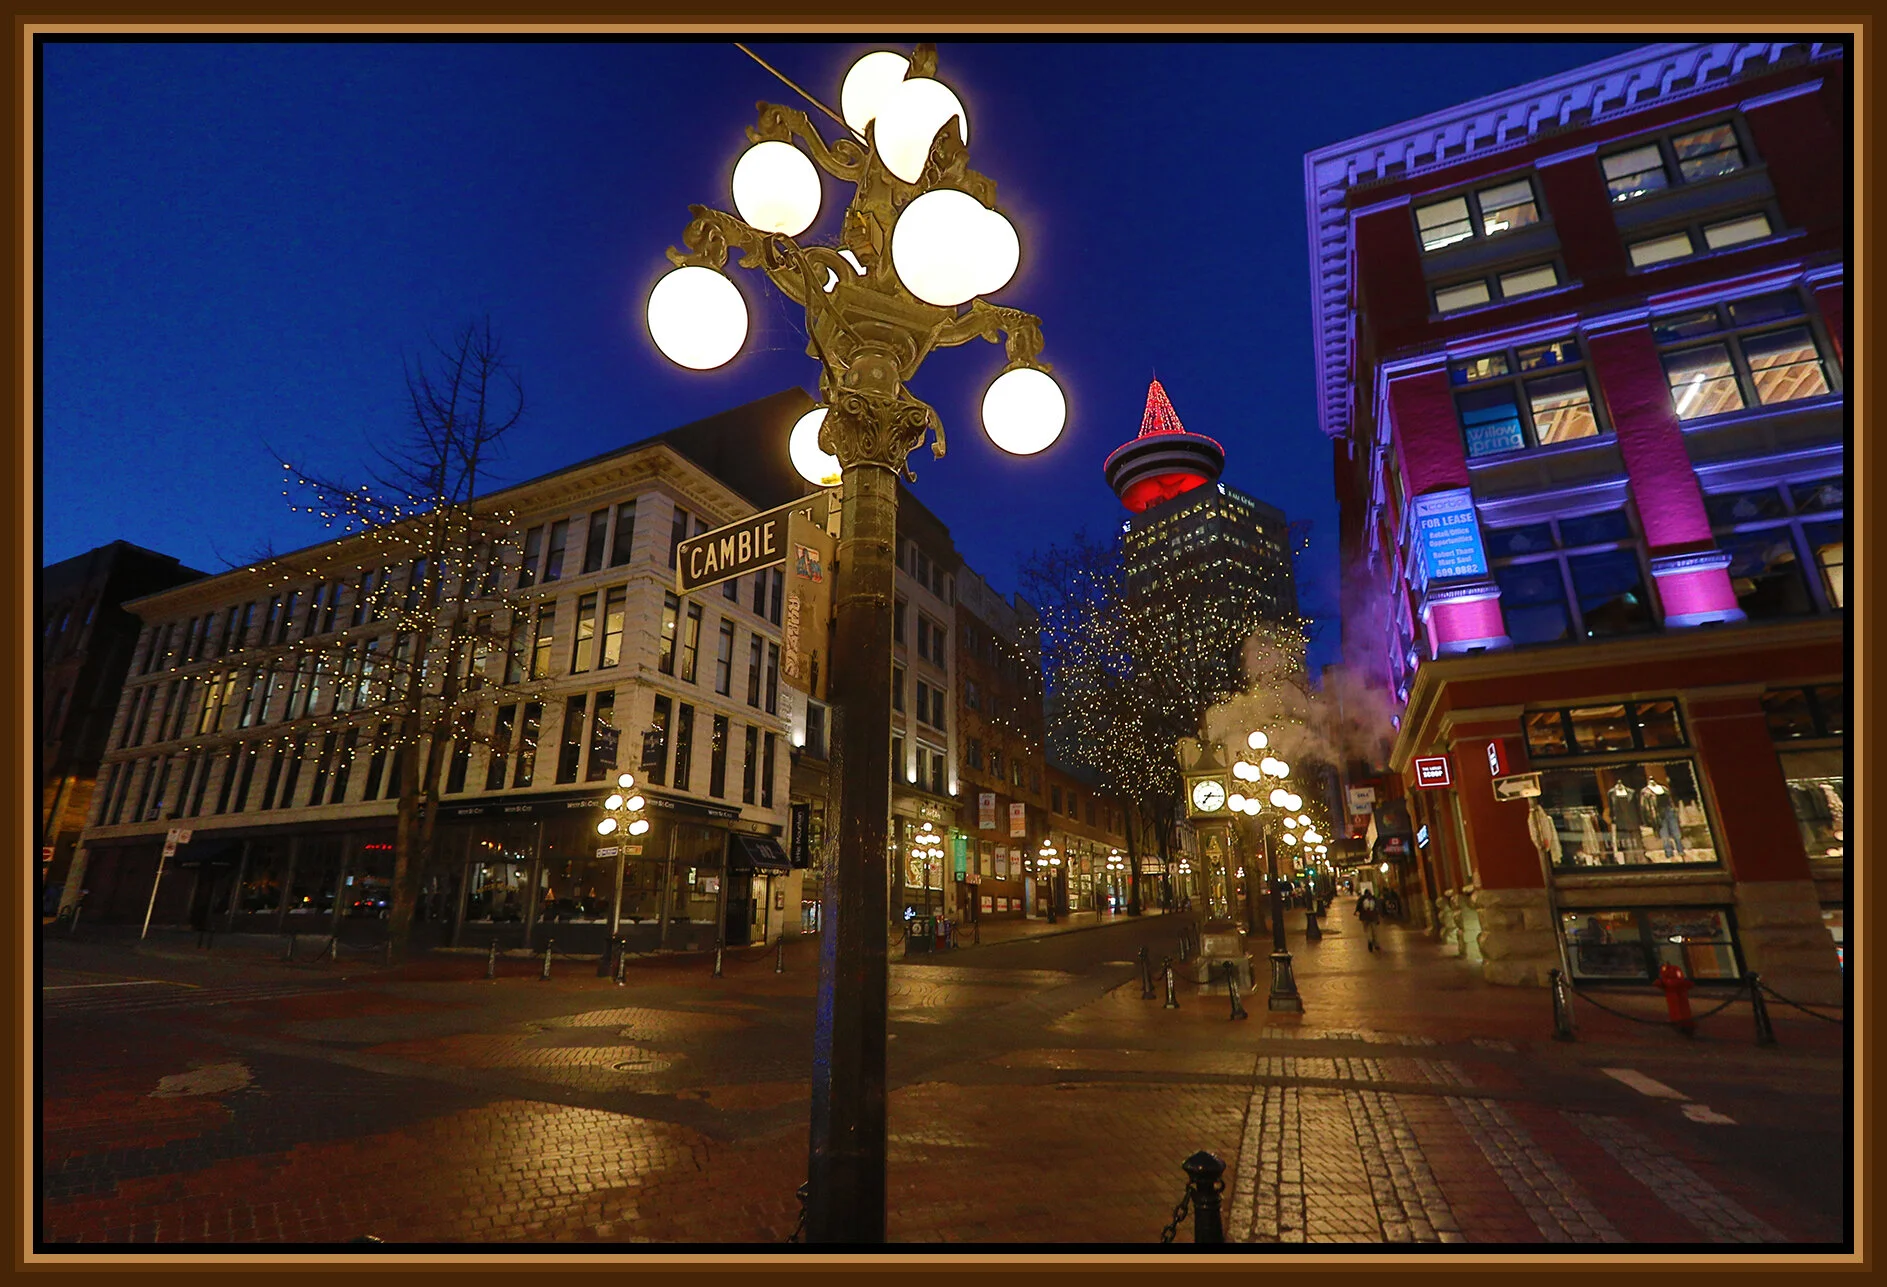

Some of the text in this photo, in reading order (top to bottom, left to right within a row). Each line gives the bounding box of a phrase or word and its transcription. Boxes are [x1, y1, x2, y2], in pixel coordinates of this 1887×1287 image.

[1421, 512, 1473, 529] FOR LEASE
[690, 520, 777, 580] CAMBIE
[1422, 770, 1443, 778] SCOOP
